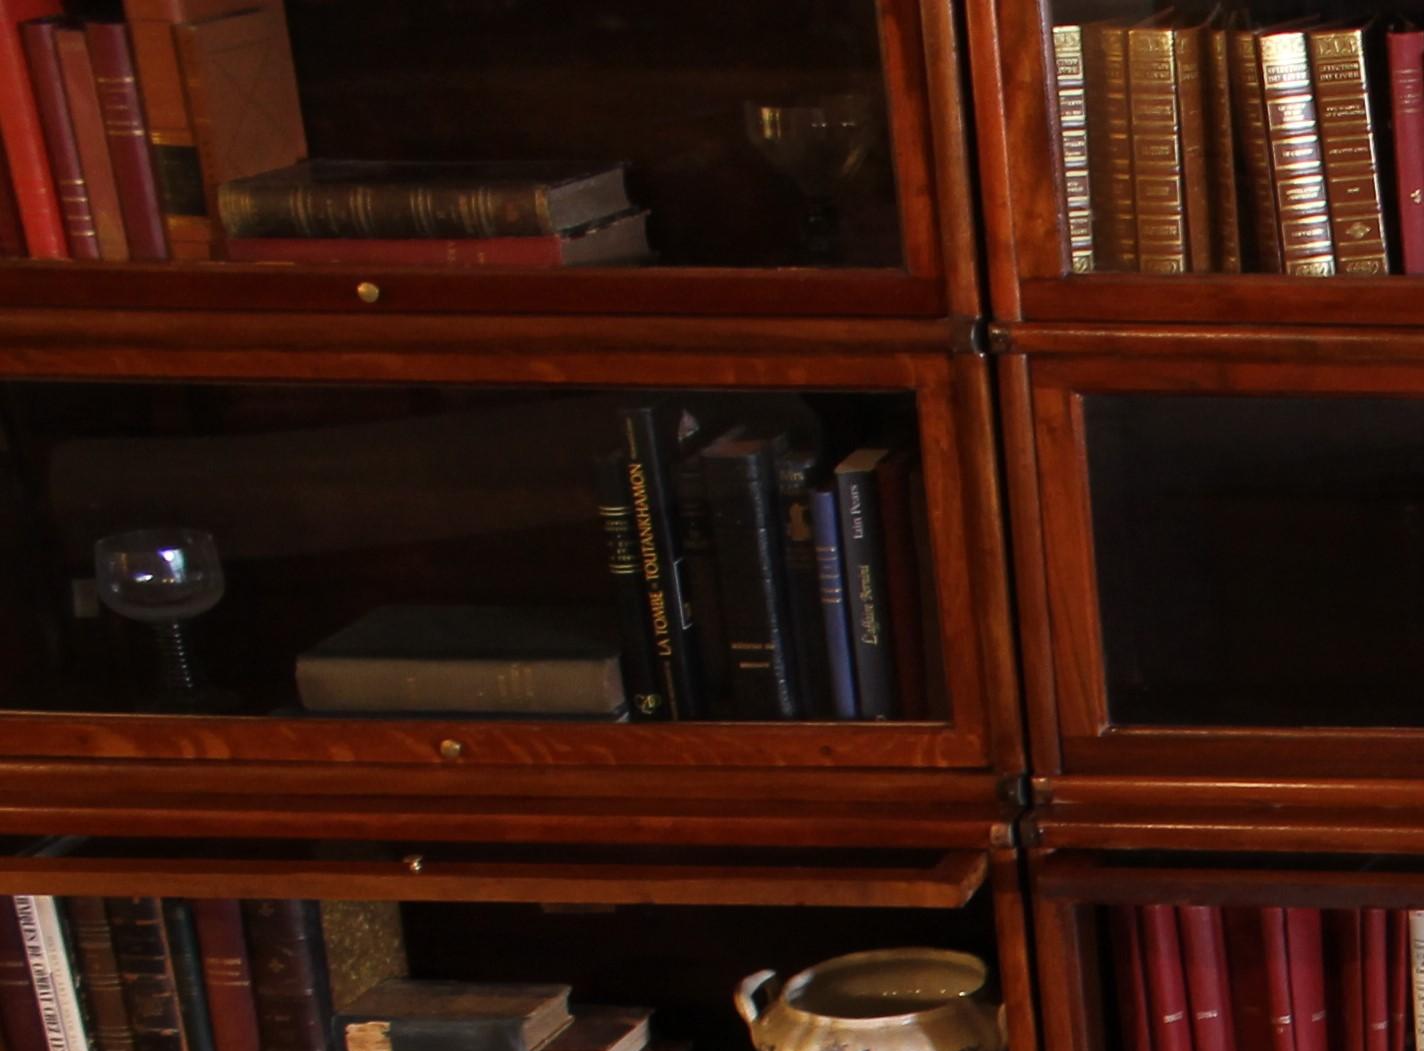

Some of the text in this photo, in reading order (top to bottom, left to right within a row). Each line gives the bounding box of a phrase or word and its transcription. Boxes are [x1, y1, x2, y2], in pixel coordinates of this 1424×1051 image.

[628, 464, 673, 657] LA TOMBE TOUTANKHAMON
